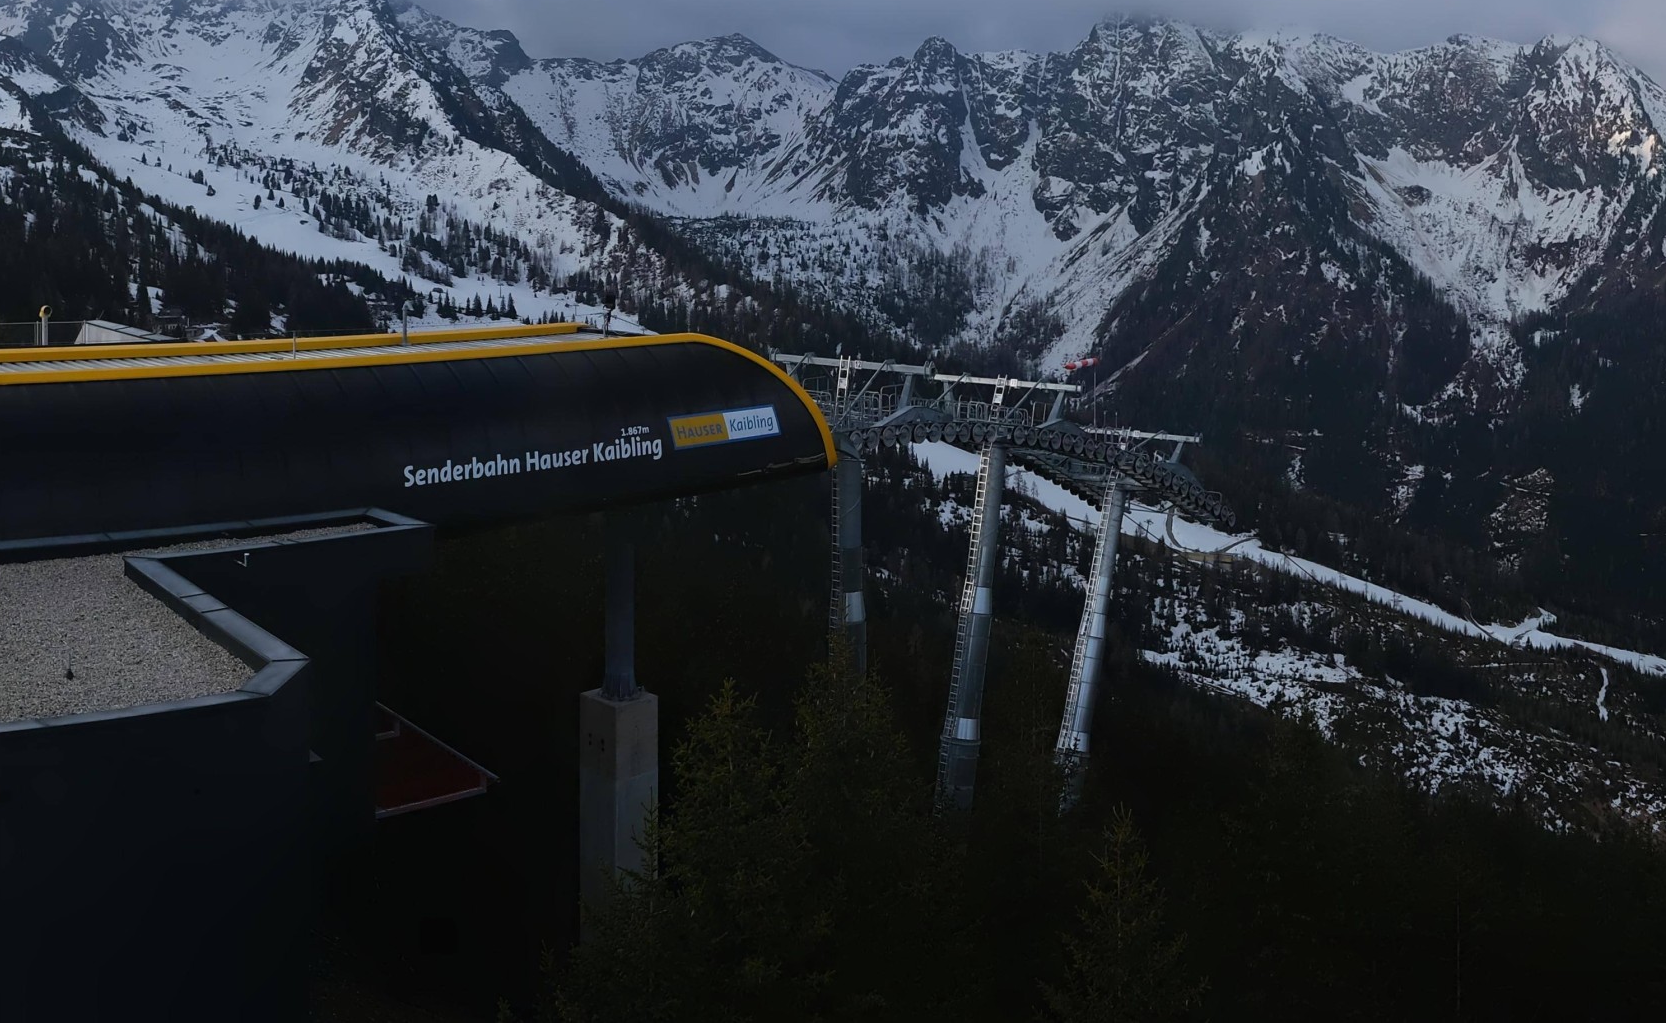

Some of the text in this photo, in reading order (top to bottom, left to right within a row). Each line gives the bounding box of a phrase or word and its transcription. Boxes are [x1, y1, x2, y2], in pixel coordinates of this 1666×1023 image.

[621, 425, 650, 437] 1.867m
[676, 415, 774, 440] HAUSER Kaibling
[404, 437, 663, 487] Senderbahn Hauser Kaibling
